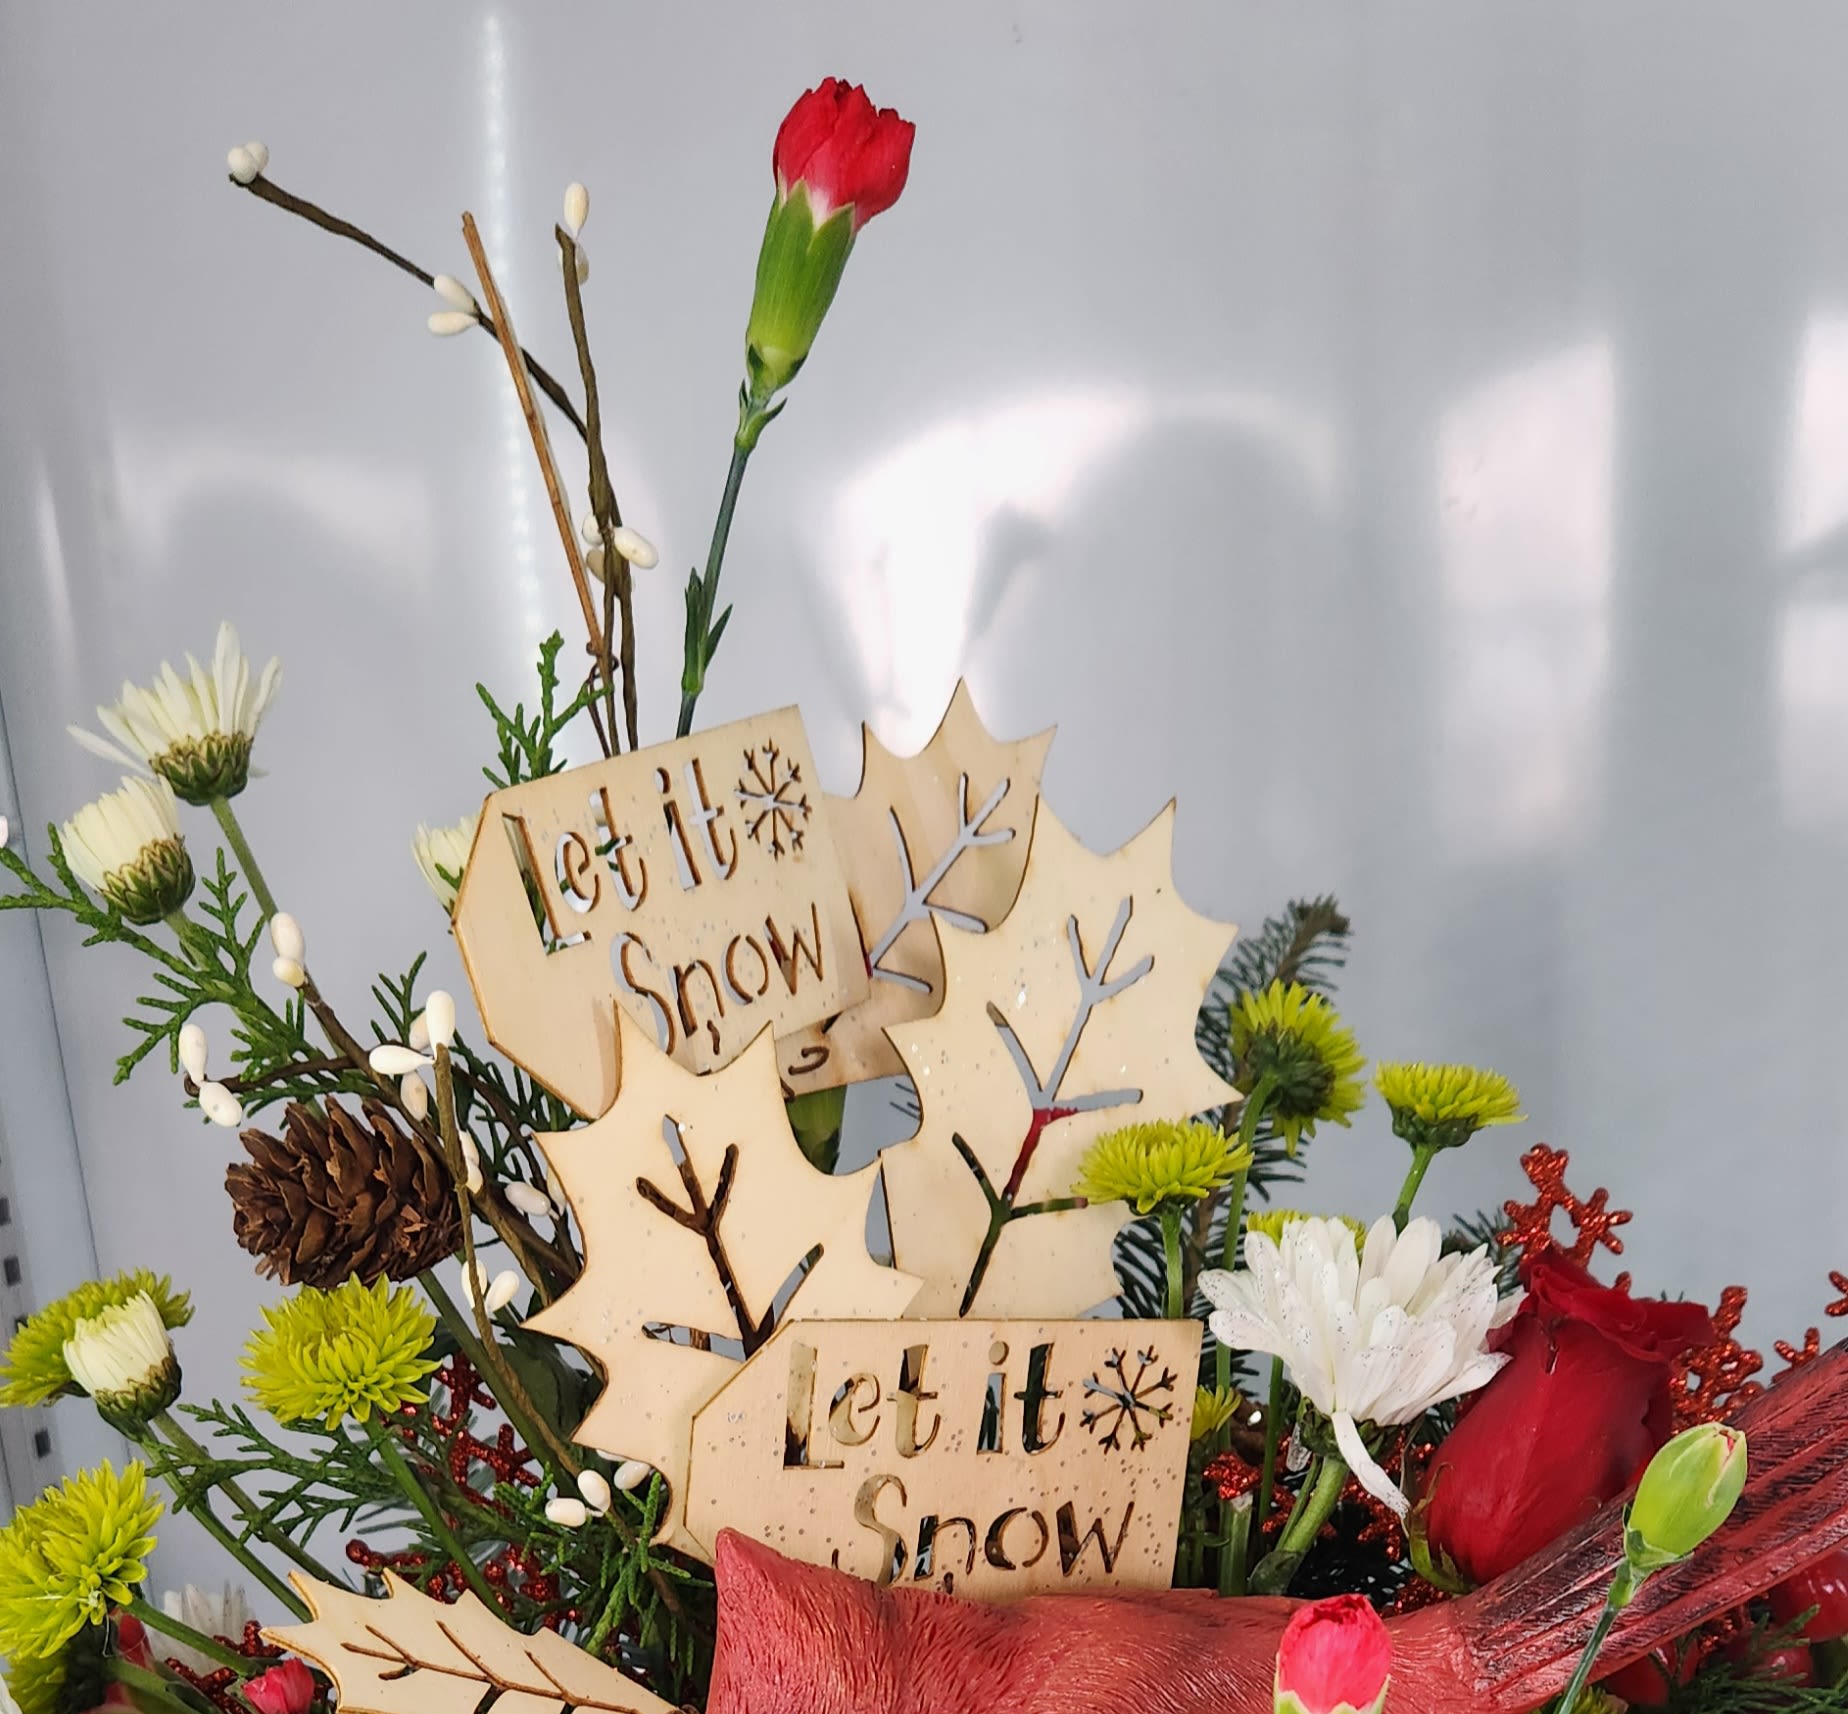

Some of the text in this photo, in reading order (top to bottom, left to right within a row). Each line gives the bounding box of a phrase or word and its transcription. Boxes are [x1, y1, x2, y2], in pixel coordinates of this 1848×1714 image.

[502, 757, 738, 956] Let it
[609, 901, 825, 1057] Snow
[782, 1340, 1066, 1470] Let it
[832, 1473, 1136, 1587] Snow
